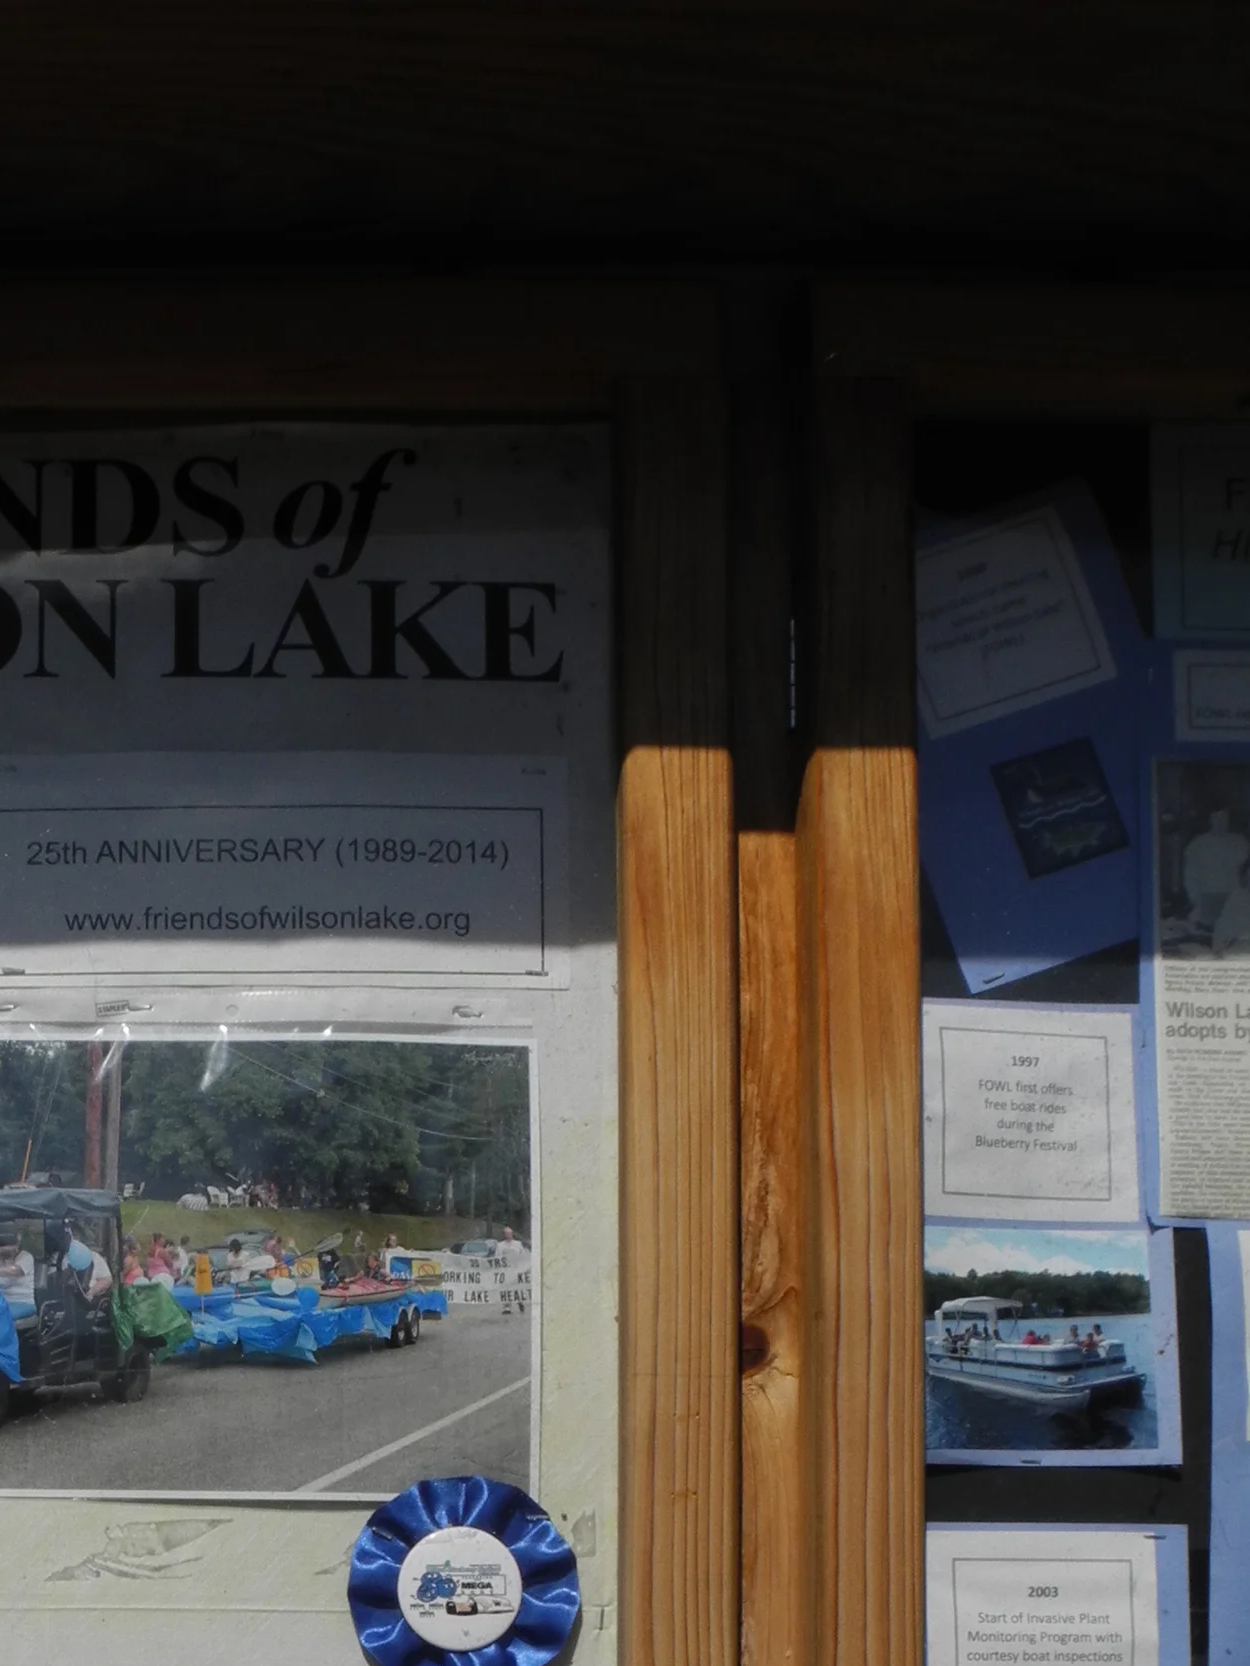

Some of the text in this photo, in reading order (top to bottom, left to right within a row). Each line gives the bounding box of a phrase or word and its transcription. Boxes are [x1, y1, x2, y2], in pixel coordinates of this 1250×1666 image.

[273, 449, 417, 579] of
[161, 580, 565, 684] LAKE
[27, 838, 508, 870] 25th ANNIVERSARY (1989-2014)
[65, 905, 469, 936] www.friendsofwilsonlake.org
[1165, 1002, 1228, 1020] Wilson
[1165, 1022, 1227, 1040] adopts
[1012, 1056, 1039, 1067] 1997
[979, 1079, 1073, 1096] FOWL first offers
[984, 1098, 1066, 1114] free boat rides
[997, 1119, 1054, 1134] during the
[975, 1135, 1077, 1152] Blueberry Festival
[443, 1271, 531, 1284] ORKING TO KE
[464, 1289, 490, 1303] LAKE
[500, 1288, 532, 1303] HEALT
[1028, 1587, 1058, 1598] 2003
[978, 1612, 1110, 1624] Start of Invasive Plant
[968, 1631, 1122, 1645] Monitoring Program with
[967, 1651, 1122, 1664] courtesy boat inspections
